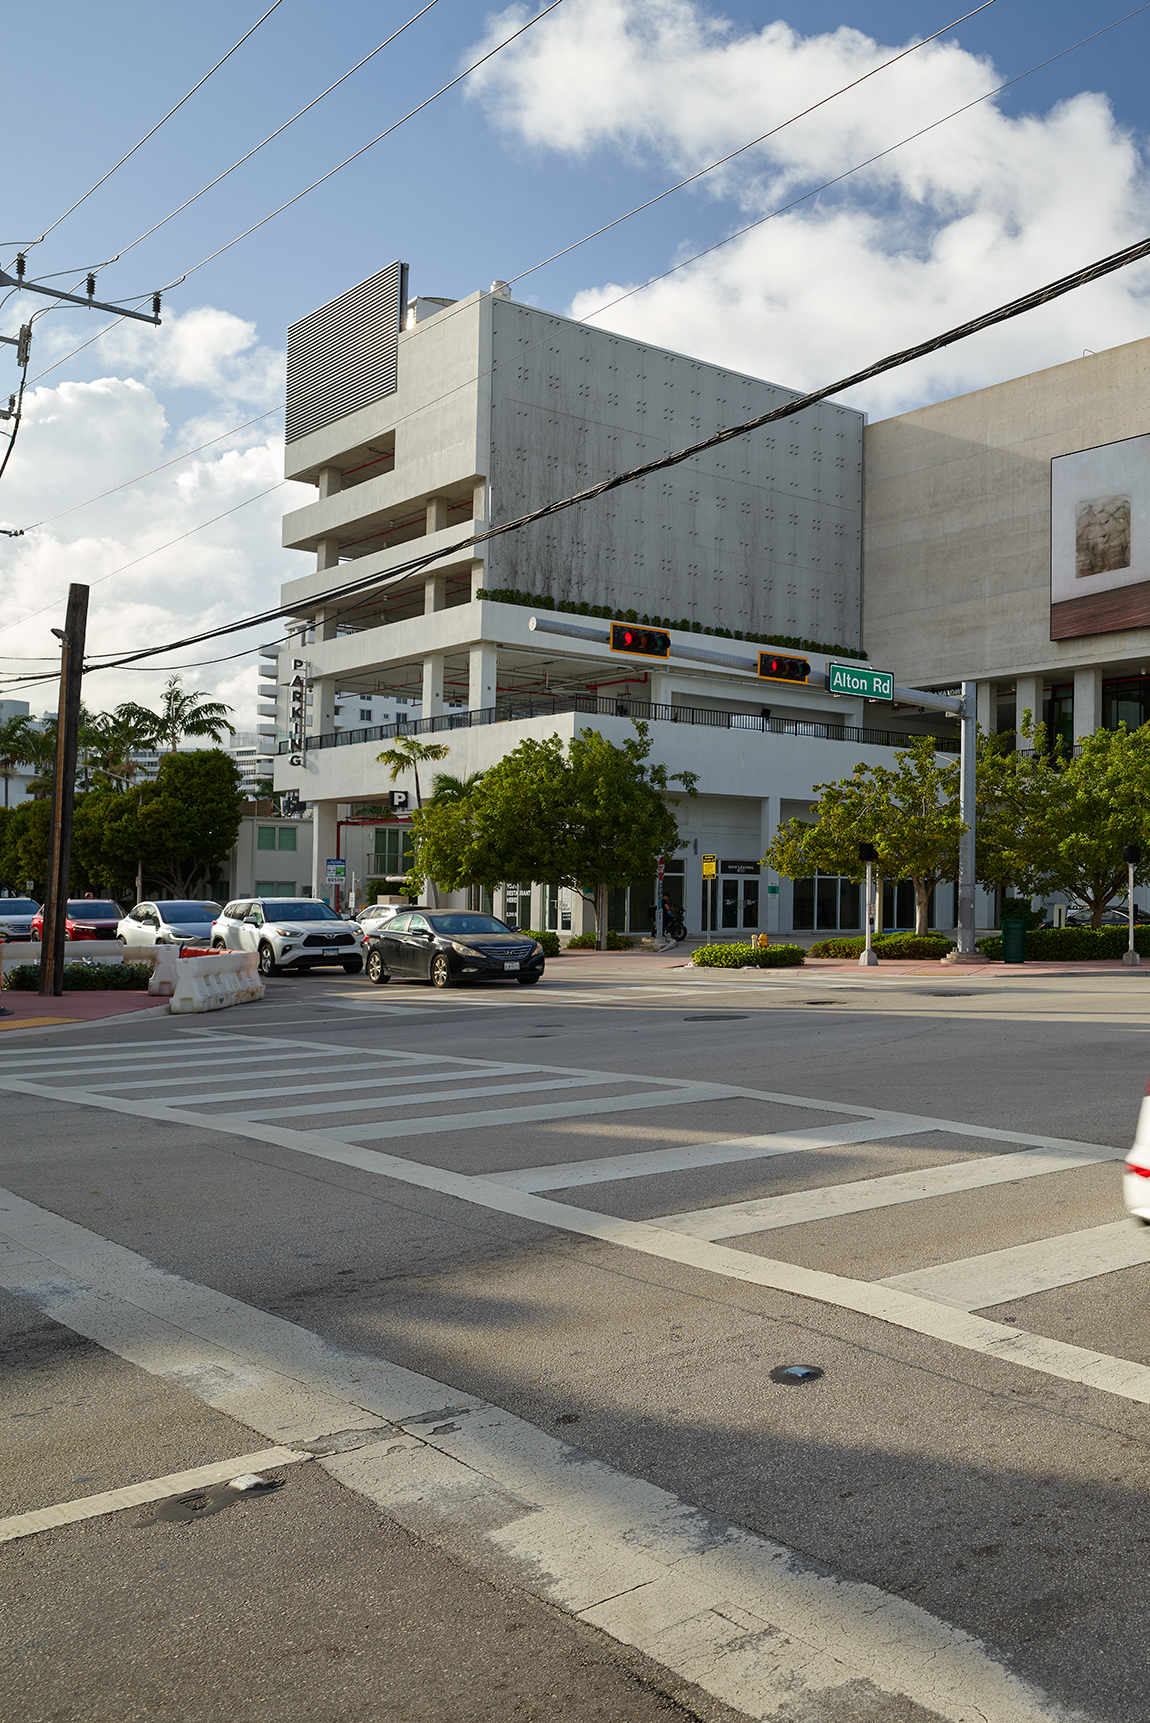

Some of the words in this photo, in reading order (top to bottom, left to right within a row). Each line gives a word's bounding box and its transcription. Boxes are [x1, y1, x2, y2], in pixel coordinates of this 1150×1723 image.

[833, 671, 868, 691] Alton
[873, 677, 890, 694] Rd
[289, 659, 304, 767] PARKING
[393, 792, 406, 805] P
